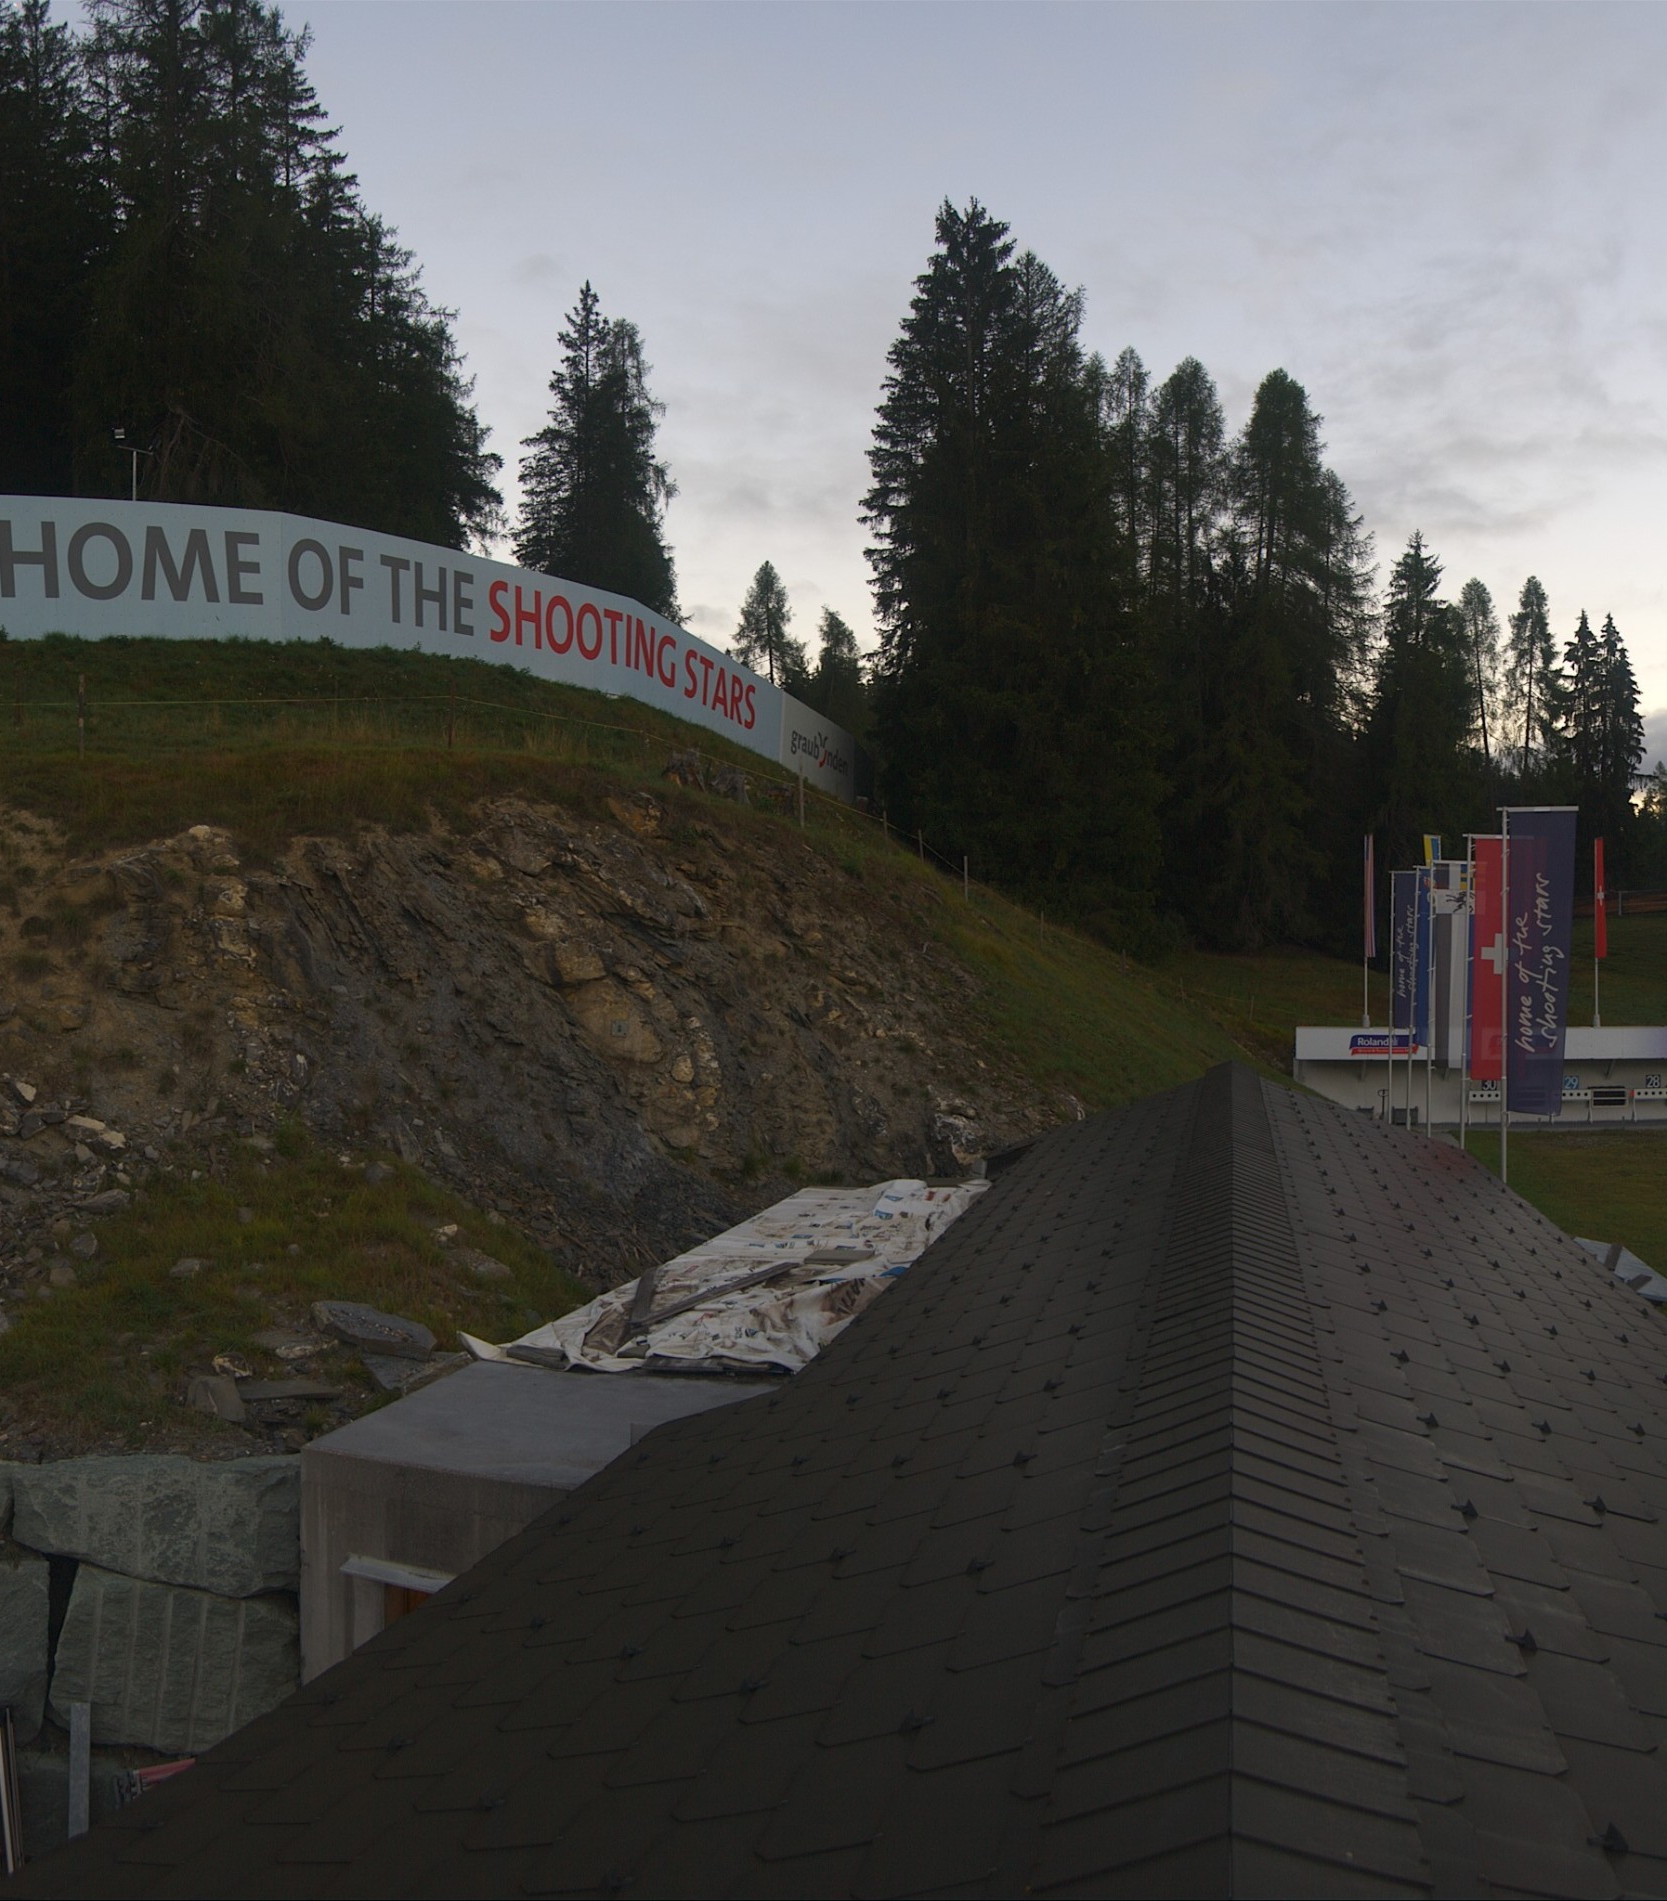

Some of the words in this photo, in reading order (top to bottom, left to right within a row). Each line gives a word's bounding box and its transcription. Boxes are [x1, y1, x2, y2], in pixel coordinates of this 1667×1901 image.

[287, 537, 365, 612] OF
[379, 553, 475, 637] THE
[488, 580, 677, 688] SHOOTING
[683, 648, 757, 730] STARS
[1515, 995, 1535, 1053] home
[1482, 1080, 1496, 1091] 30
[1564, 1077, 1578, 1089] 29
[1647, 1076, 1660, 1088] 28
